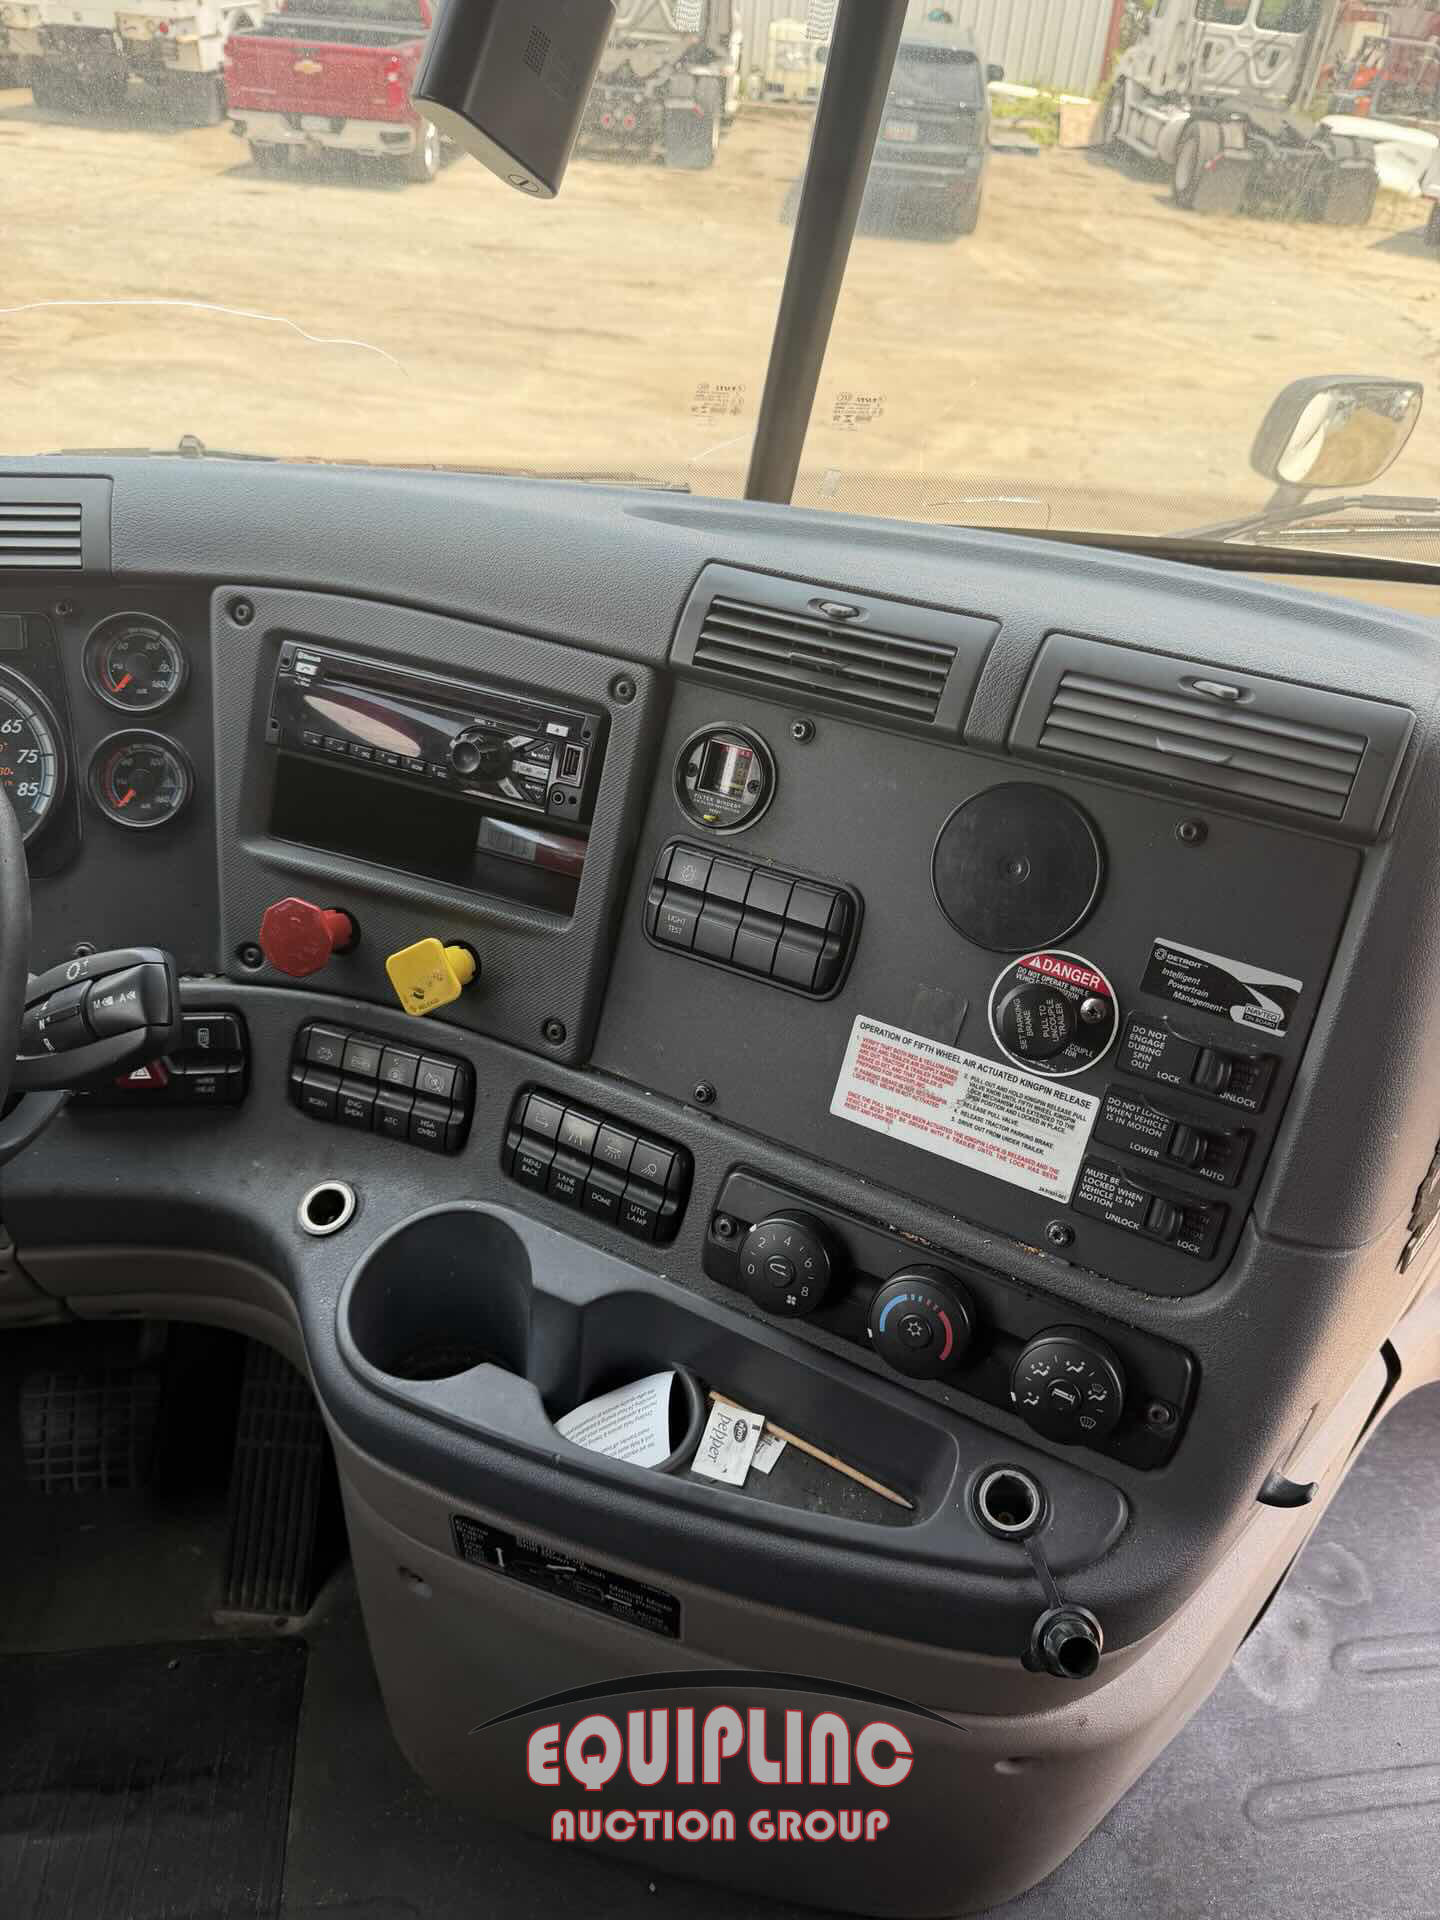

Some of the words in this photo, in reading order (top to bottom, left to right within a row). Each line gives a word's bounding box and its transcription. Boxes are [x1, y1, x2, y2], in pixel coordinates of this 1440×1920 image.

[0, 719, 23, 734] 65
[16, 749, 40, 764] 75
[16, 782, 40, 796] 85
[1167, 954, 1201, 969] DETROIT
[1042, 959, 1101, 989] DANGER
[1162, 967, 1201, 985] Intelligent
[1168, 979, 1209, 998] Powertrain
[1013, 999, 1023, 1032] PARKING
[1038, 1004, 1046, 1016] TO
[1023, 1010, 1033, 1036] BRAKE
[1040, 1017, 1050, 1037] PULL
[1046, 999, 1059, 1041] UNCOUPLE
[1055, 1002, 1066, 1036] TRAILER
[1245, 1014, 1256, 1023] ON
[1257, 1017, 1276, 1028] BOARD
[1133, 1025, 1146, 1034] DO
[1148, 1029, 1168, 1041] NOT
[1018, 1034, 1027, 1049] SET
[1128, 1041, 1162, 1057] DURING
[1129, 1034, 1166, 1050] ENGAGE
[859, 1020, 901, 1042] OPERATION
[901, 1035, 913, 1046] OF
[912, 1040, 935, 1054] FIFTH
[934, 1047, 963, 1064] WHEEL
[962, 1057, 977, 1069] AIR
[976, 1062, 1019, 1083] ACTUATED
[1018, 1077, 1053, 1096] KINGPIN
[1052, 1089, 1092, 1110] RELEASE
[1131, 1060, 1150, 1071] OUT
[1133, 1052, 1152, 1063] SPIN
[1157, 1071, 1182, 1085] LOCK
[968, 1081, 985, 1091] VALVE
[985, 1087, 1000, 1097] KNOB
[1001, 1093, 1017, 1103] UNTIL
[1017, 1099, 1033, 1108] FIFTH
[1033, 1104, 1052, 1115] WHEEL
[1053, 1111, 1076, 1124] KINGPIN
[970, 1075, 985, 1084] PULL
[984, 1080, 995, 1088] OUT
[996, 1084, 1008, 1093] AND
[1008, 1088, 1023, 1098] HOLD
[1023, 1094, 1046, 1106] KINGPIN
[1046, 1102, 1071, 1115] RELEASE
[1072, 1111, 1087, 1121] PULL
[1108, 1097, 1121, 1107] DO
[1122, 1101, 1141, 1113] NOT
[1219, 1092, 1257, 1109] UNLOCK
[962, 1101, 986, 1114] RELEASE
[986, 1110, 1001, 1119] PULL
[965, 1093, 980, 1103] OPEN
[980, 1099, 1005, 1112] POSITION
[1004, 1107, 1017, 1116] AND
[1016, 1112, 1039, 1124] LOCKED
[966, 1087, 981, 1097] LOCK
[981, 1093, 1014, 1108] MECHANISM
[1013, 1104, 1026, 1112] HAS
[1025, 1108, 1055, 1123] EXTENDED
[1064, 1122, 1075, 1130] THE
[959, 1110, 984, 1123] RELEASE
[984, 1119, 1009, 1132] TRACTOR
[1009, 1128, 1034, 1141] PARKING
[1106, 1105, 1132, 1118] WHEN
[1134, 1112, 1169, 1132] VEHICLE
[1106, 1113, 1114, 1121] IS
[1115, 1116, 1125, 1126] IN
[1127, 1120, 1163, 1138] MOTION
[956, 1118, 973, 1129] DRIVE
[973, 1124, 985, 1133] OUT
[985, 1128, 1001, 1139] FROM
[1001, 1134, 1020, 1145] UNDER
[1130, 1142, 1160, 1158] LOWER
[522, 1164, 538, 1177] BACK
[523, 1156, 542, 1169] MENU
[558, 1173, 575, 1186] LANE
[1085, 1168, 1109, 1181] MUST
[1110, 1175, 1120, 1185] BE
[1199, 1167, 1225, 1182] AUTO
[556, 1182, 574, 1194] ALERT
[1081, 1183, 1114, 1200] VEHICLE
[1115, 1195, 1123, 1203] IS
[1124, 1199, 1135, 1207] IN
[1083, 1175, 1116, 1192] LOCKED
[1117, 1187, 1144, 1202] WHEN
[591, 1192, 612, 1207] DOME
[1078, 1191, 1113, 1208] MOTION
[630, 1204, 647, 1217] UTLY
[627, 1213, 647, 1227] LAMP
[1105, 1212, 1140, 1230] UNLOCK
[758, 1236, 766, 1249] 2
[784, 1236, 792, 1248] 4
[1177, 1240, 1200, 1253] LOCK
[747, 1264, 755, 1275] 0
[804, 1257, 812, 1269] 6
[801, 1286, 809, 1297] 8
[703, 1411, 735, 1465] pepper
